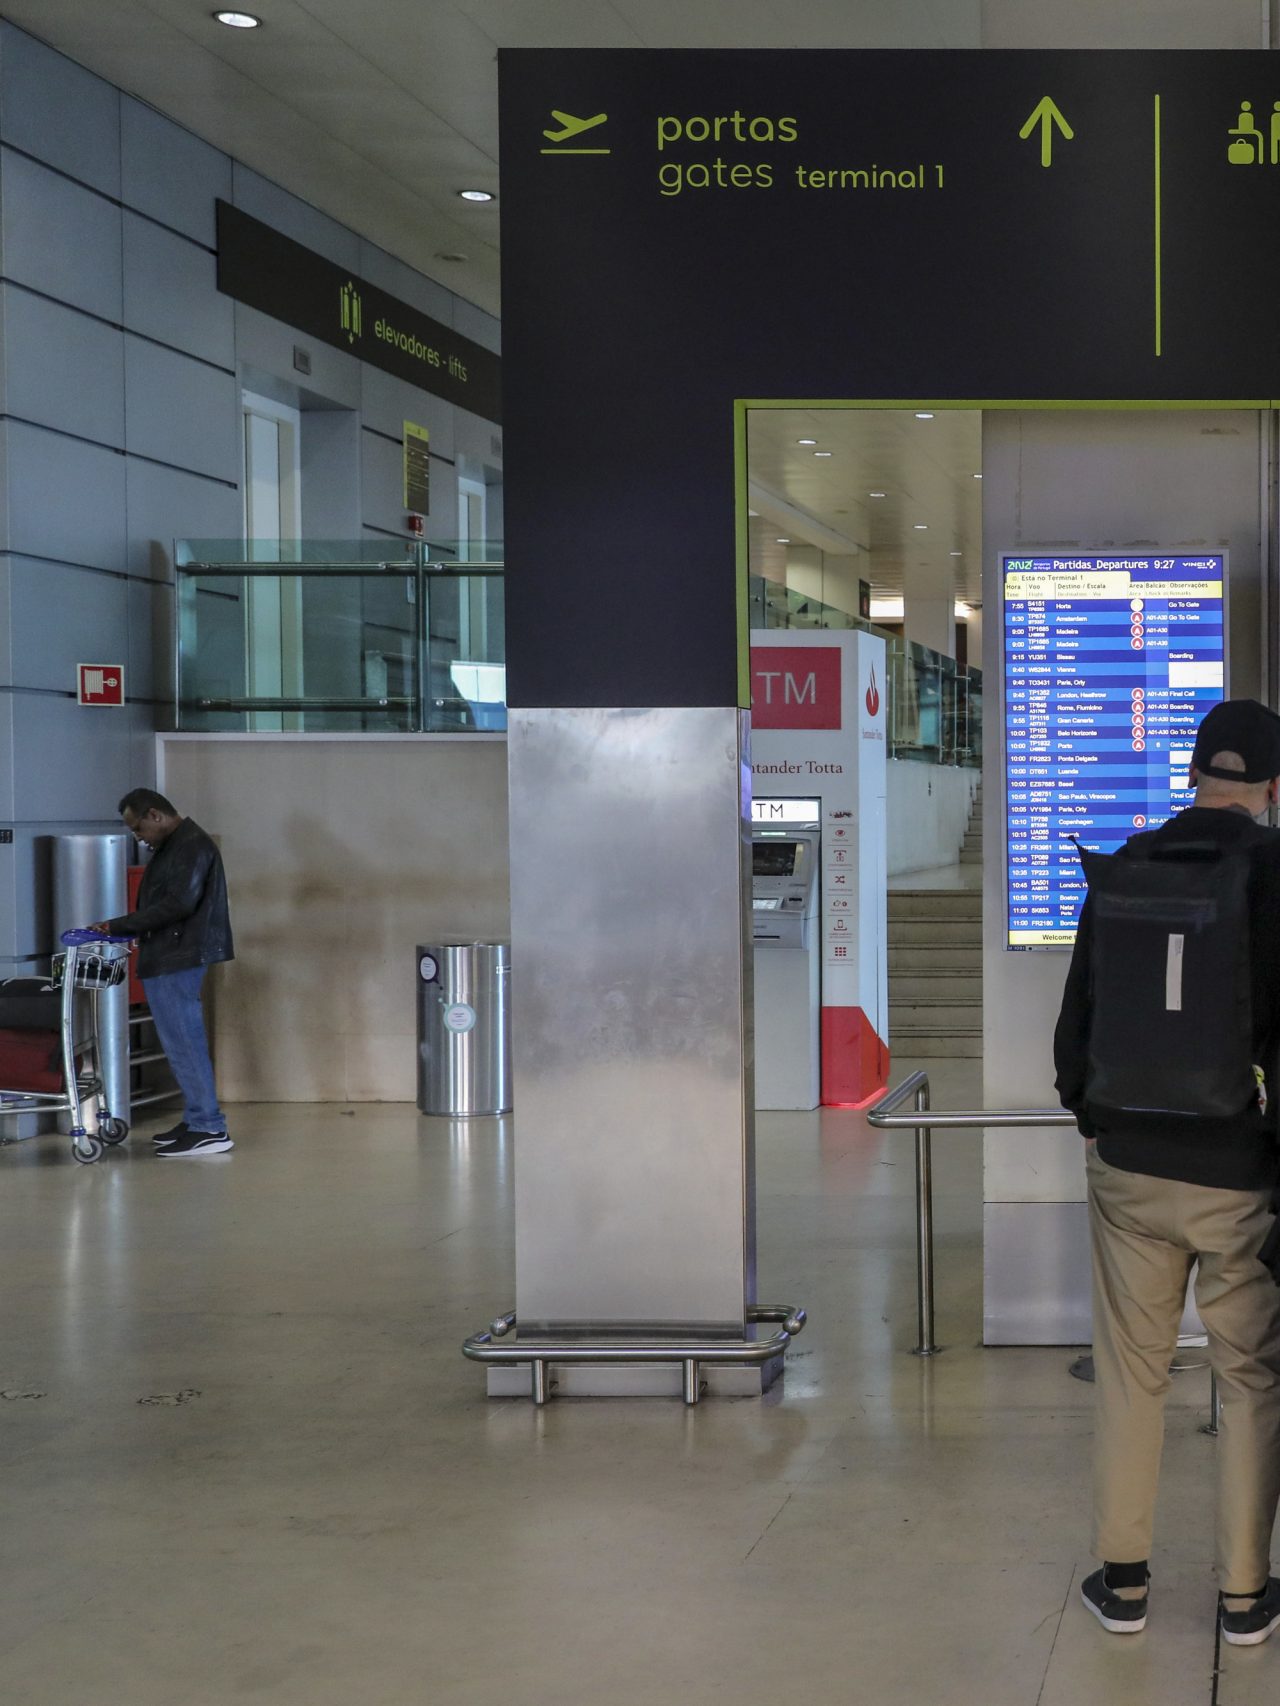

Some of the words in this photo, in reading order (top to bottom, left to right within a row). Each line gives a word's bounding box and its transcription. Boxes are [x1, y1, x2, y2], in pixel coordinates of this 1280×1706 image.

[658, 110, 797, 150] portas
[659, 158, 773, 196] gates
[796, 164, 924, 188] terminal
[935, 165, 943, 188] 1
[374, 318, 440, 368] elevadores
[448, 354, 468, 382] lifts
[1053, 560, 1148, 571] Partidas_Departures
[1154, 560, 1175, 569] 9:27
[751, 671, 816, 705] TM
[752, 760, 803, 774] tander
[805, 760, 843, 774] Totta
[751, 803, 784, 819] TM
